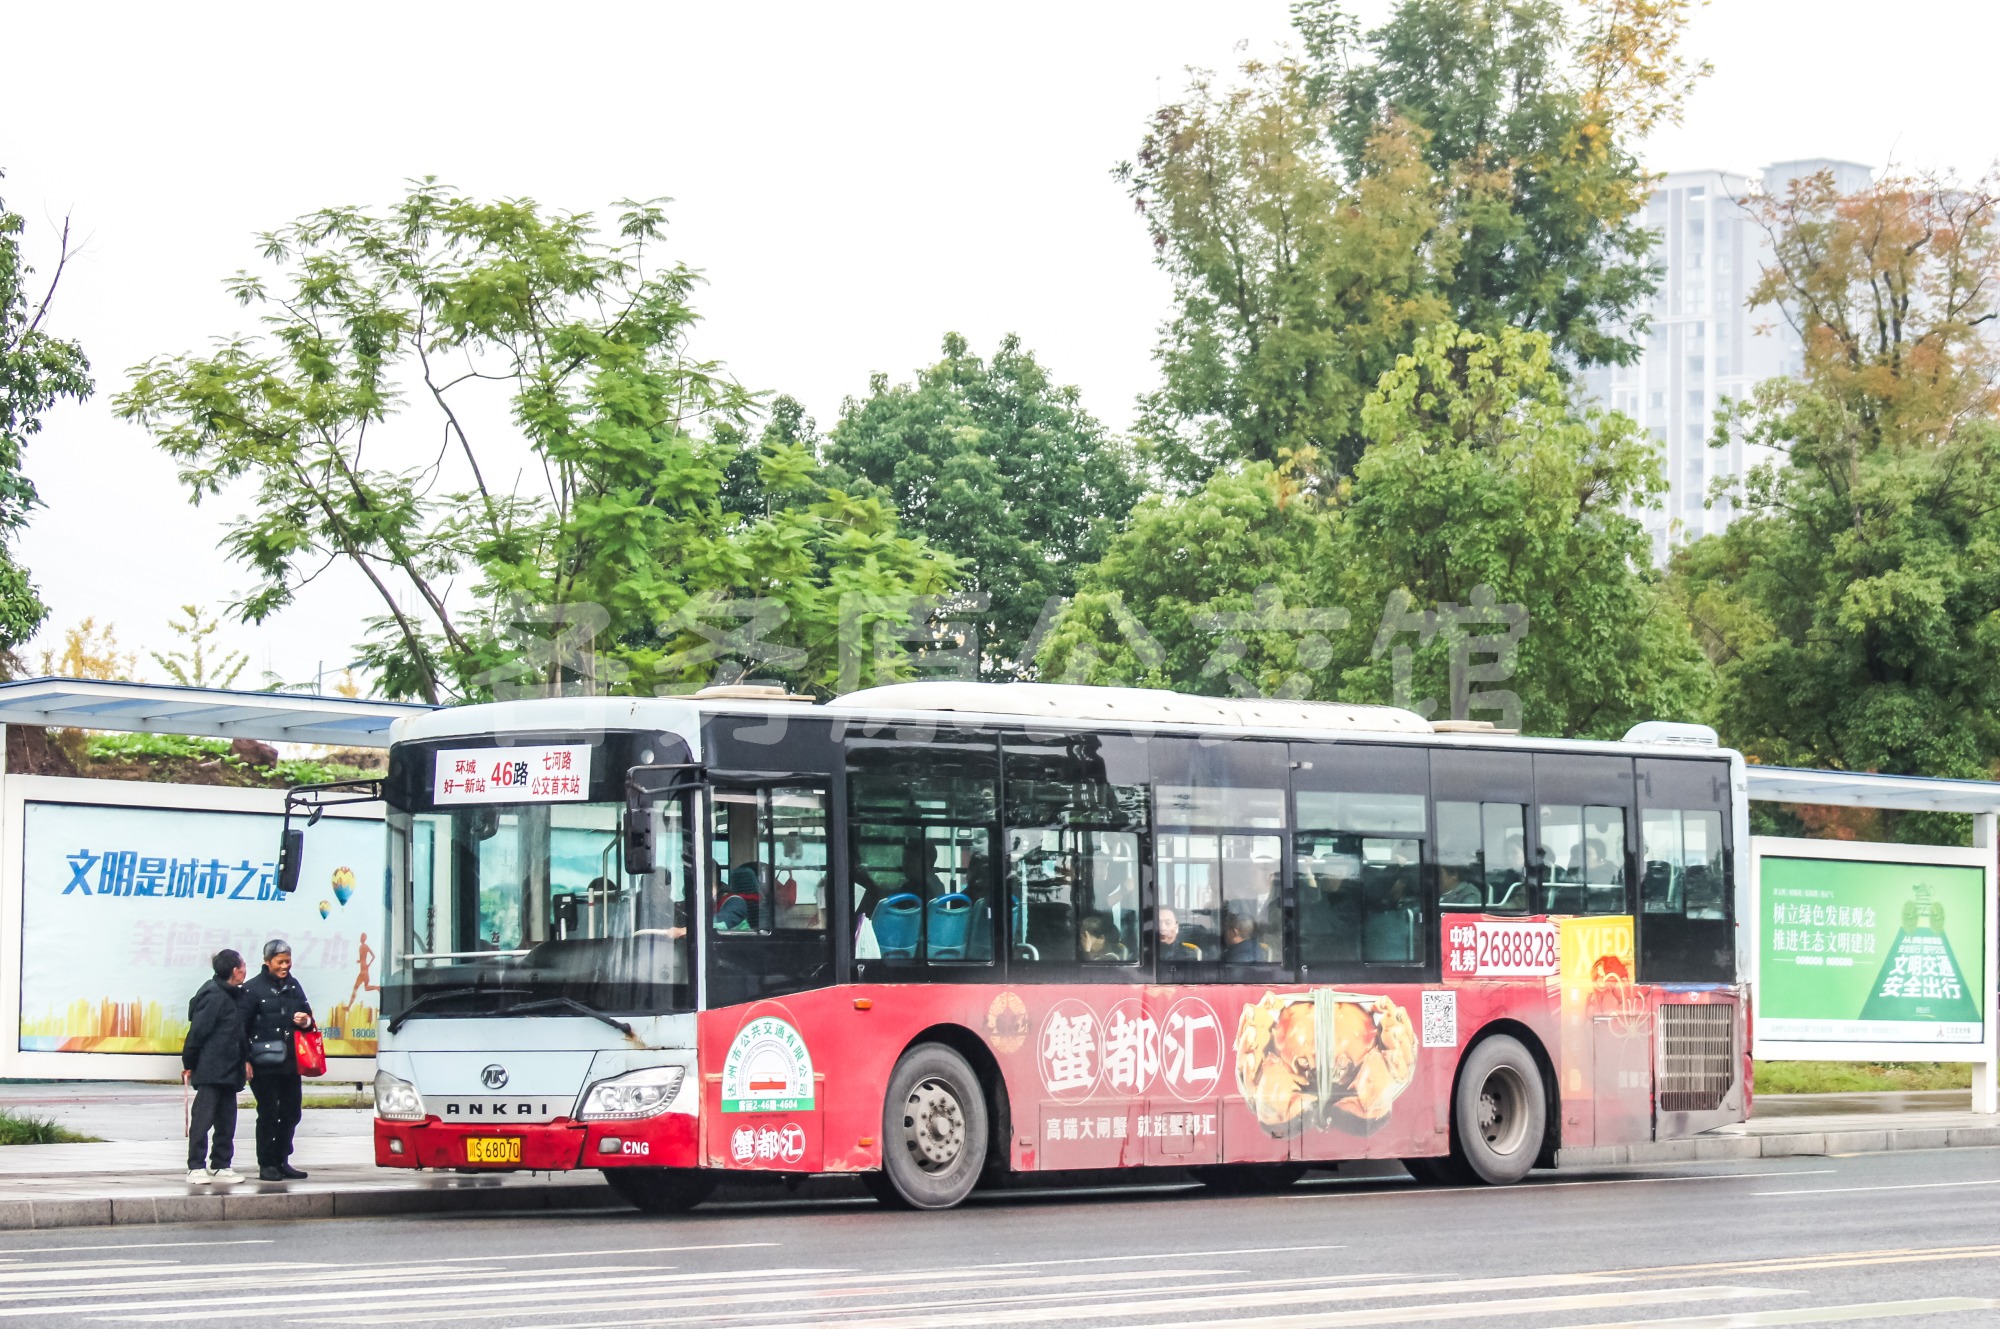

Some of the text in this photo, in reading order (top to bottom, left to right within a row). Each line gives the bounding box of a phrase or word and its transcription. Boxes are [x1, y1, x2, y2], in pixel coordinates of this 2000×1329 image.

[455, 759, 476, 775] 环城
[542, 750, 572, 771] 七河路
[444, 777, 486, 795] 好一新站
[490, 761, 529, 787] 46路
[531, 775, 580, 796] 公交首末站
[1773, 902, 1876, 928] 树立绿色发展观念
[1449, 925, 1476, 948] 中秋
[1773, 929, 1876, 954] 推进生态文明建设
[1449, 949, 1476, 972] 礼券
[1479, 930, 1556, 968] 2688828
[1889, 954, 1956, 978] 文明交通
[1879, 975, 1962, 1000] 安全出行
[727, 1021, 808, 1098] 达州市公共交通有限公司
[1044, 1008, 1220, 1093] 蟹都汇
[446, 1103, 547, 1115] ANKAI
[1046, 1116, 1128, 1141] 高端大闸蟹
[622, 1140, 650, 1155] CNG
[733, 1127, 803, 1160] 蟹都汇
